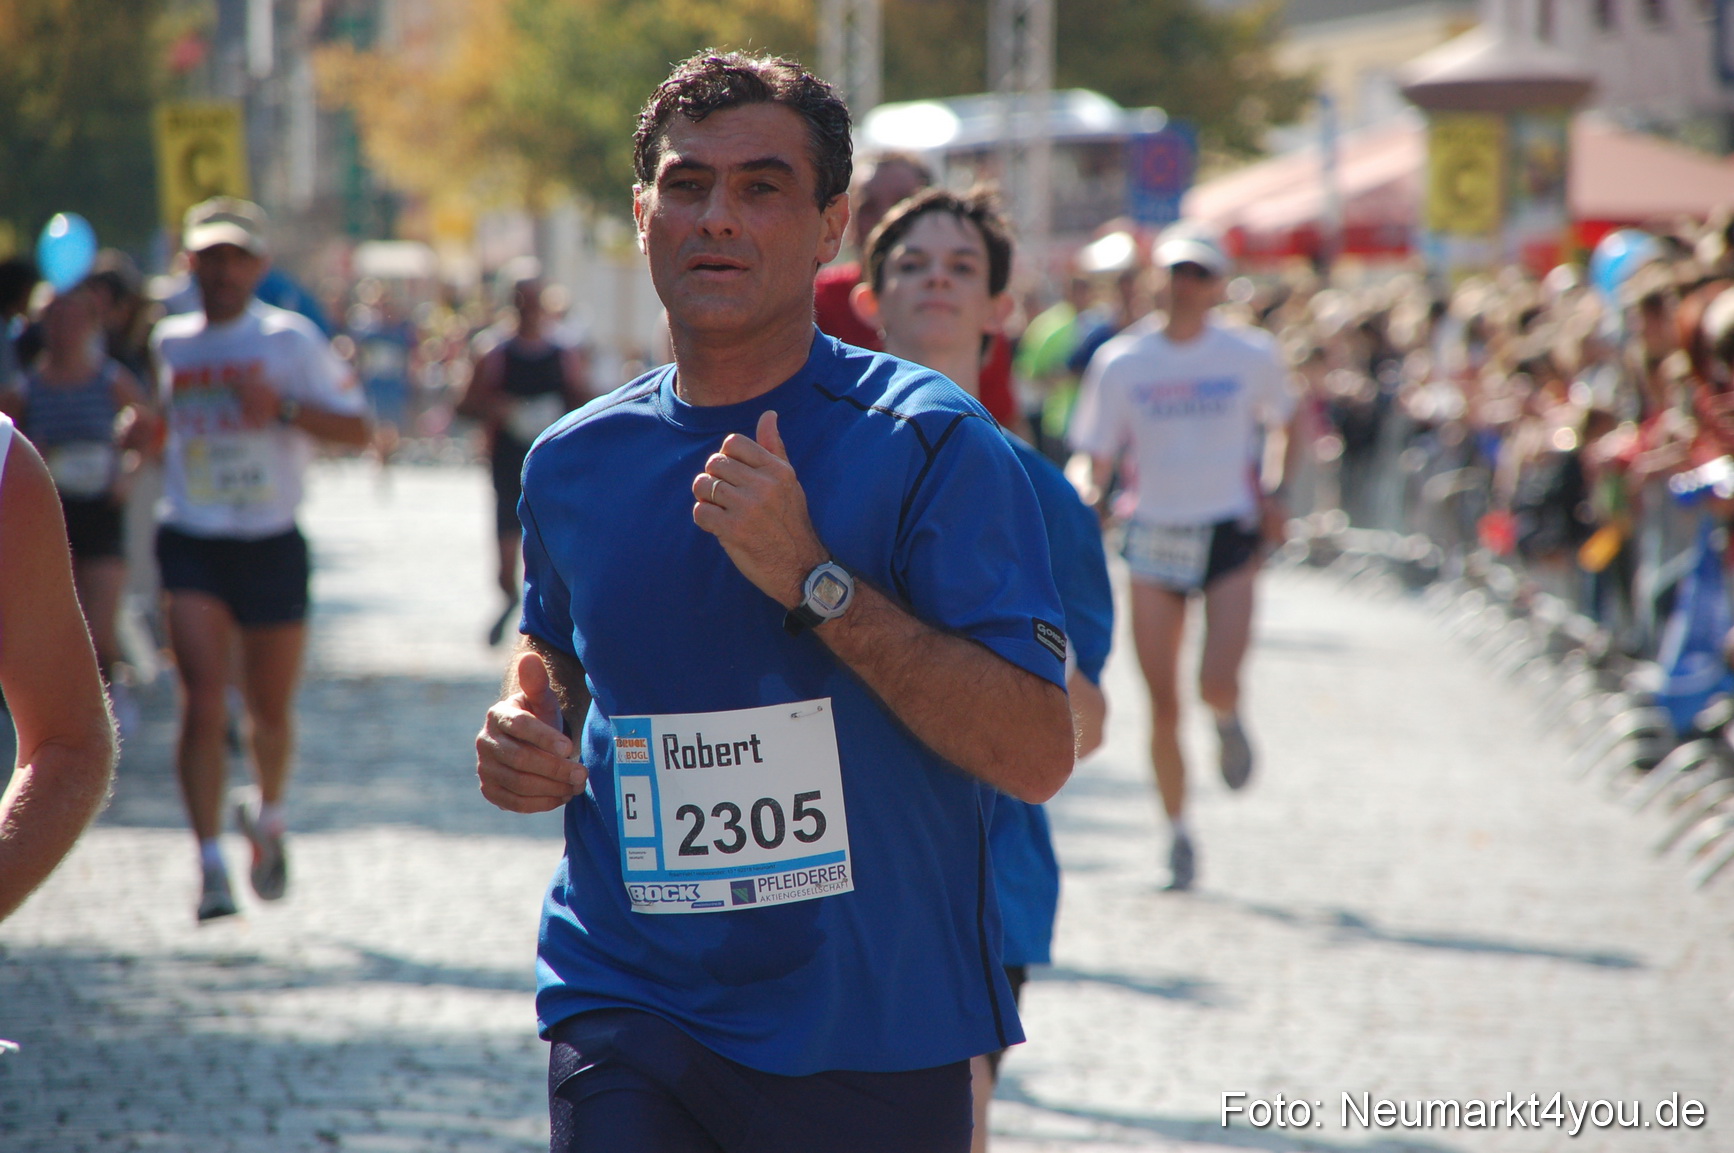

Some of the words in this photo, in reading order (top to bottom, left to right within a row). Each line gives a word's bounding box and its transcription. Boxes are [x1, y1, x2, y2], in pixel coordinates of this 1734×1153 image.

[662, 733, 763, 770] Robert
[625, 793, 637, 820] C
[675, 790, 827, 856] 2305
[758, 864, 847, 893] PFLEIDERER
[760, 881, 849, 903] AKTIENGESELLSCHAFT
[629, 884, 700, 902] BOCK
